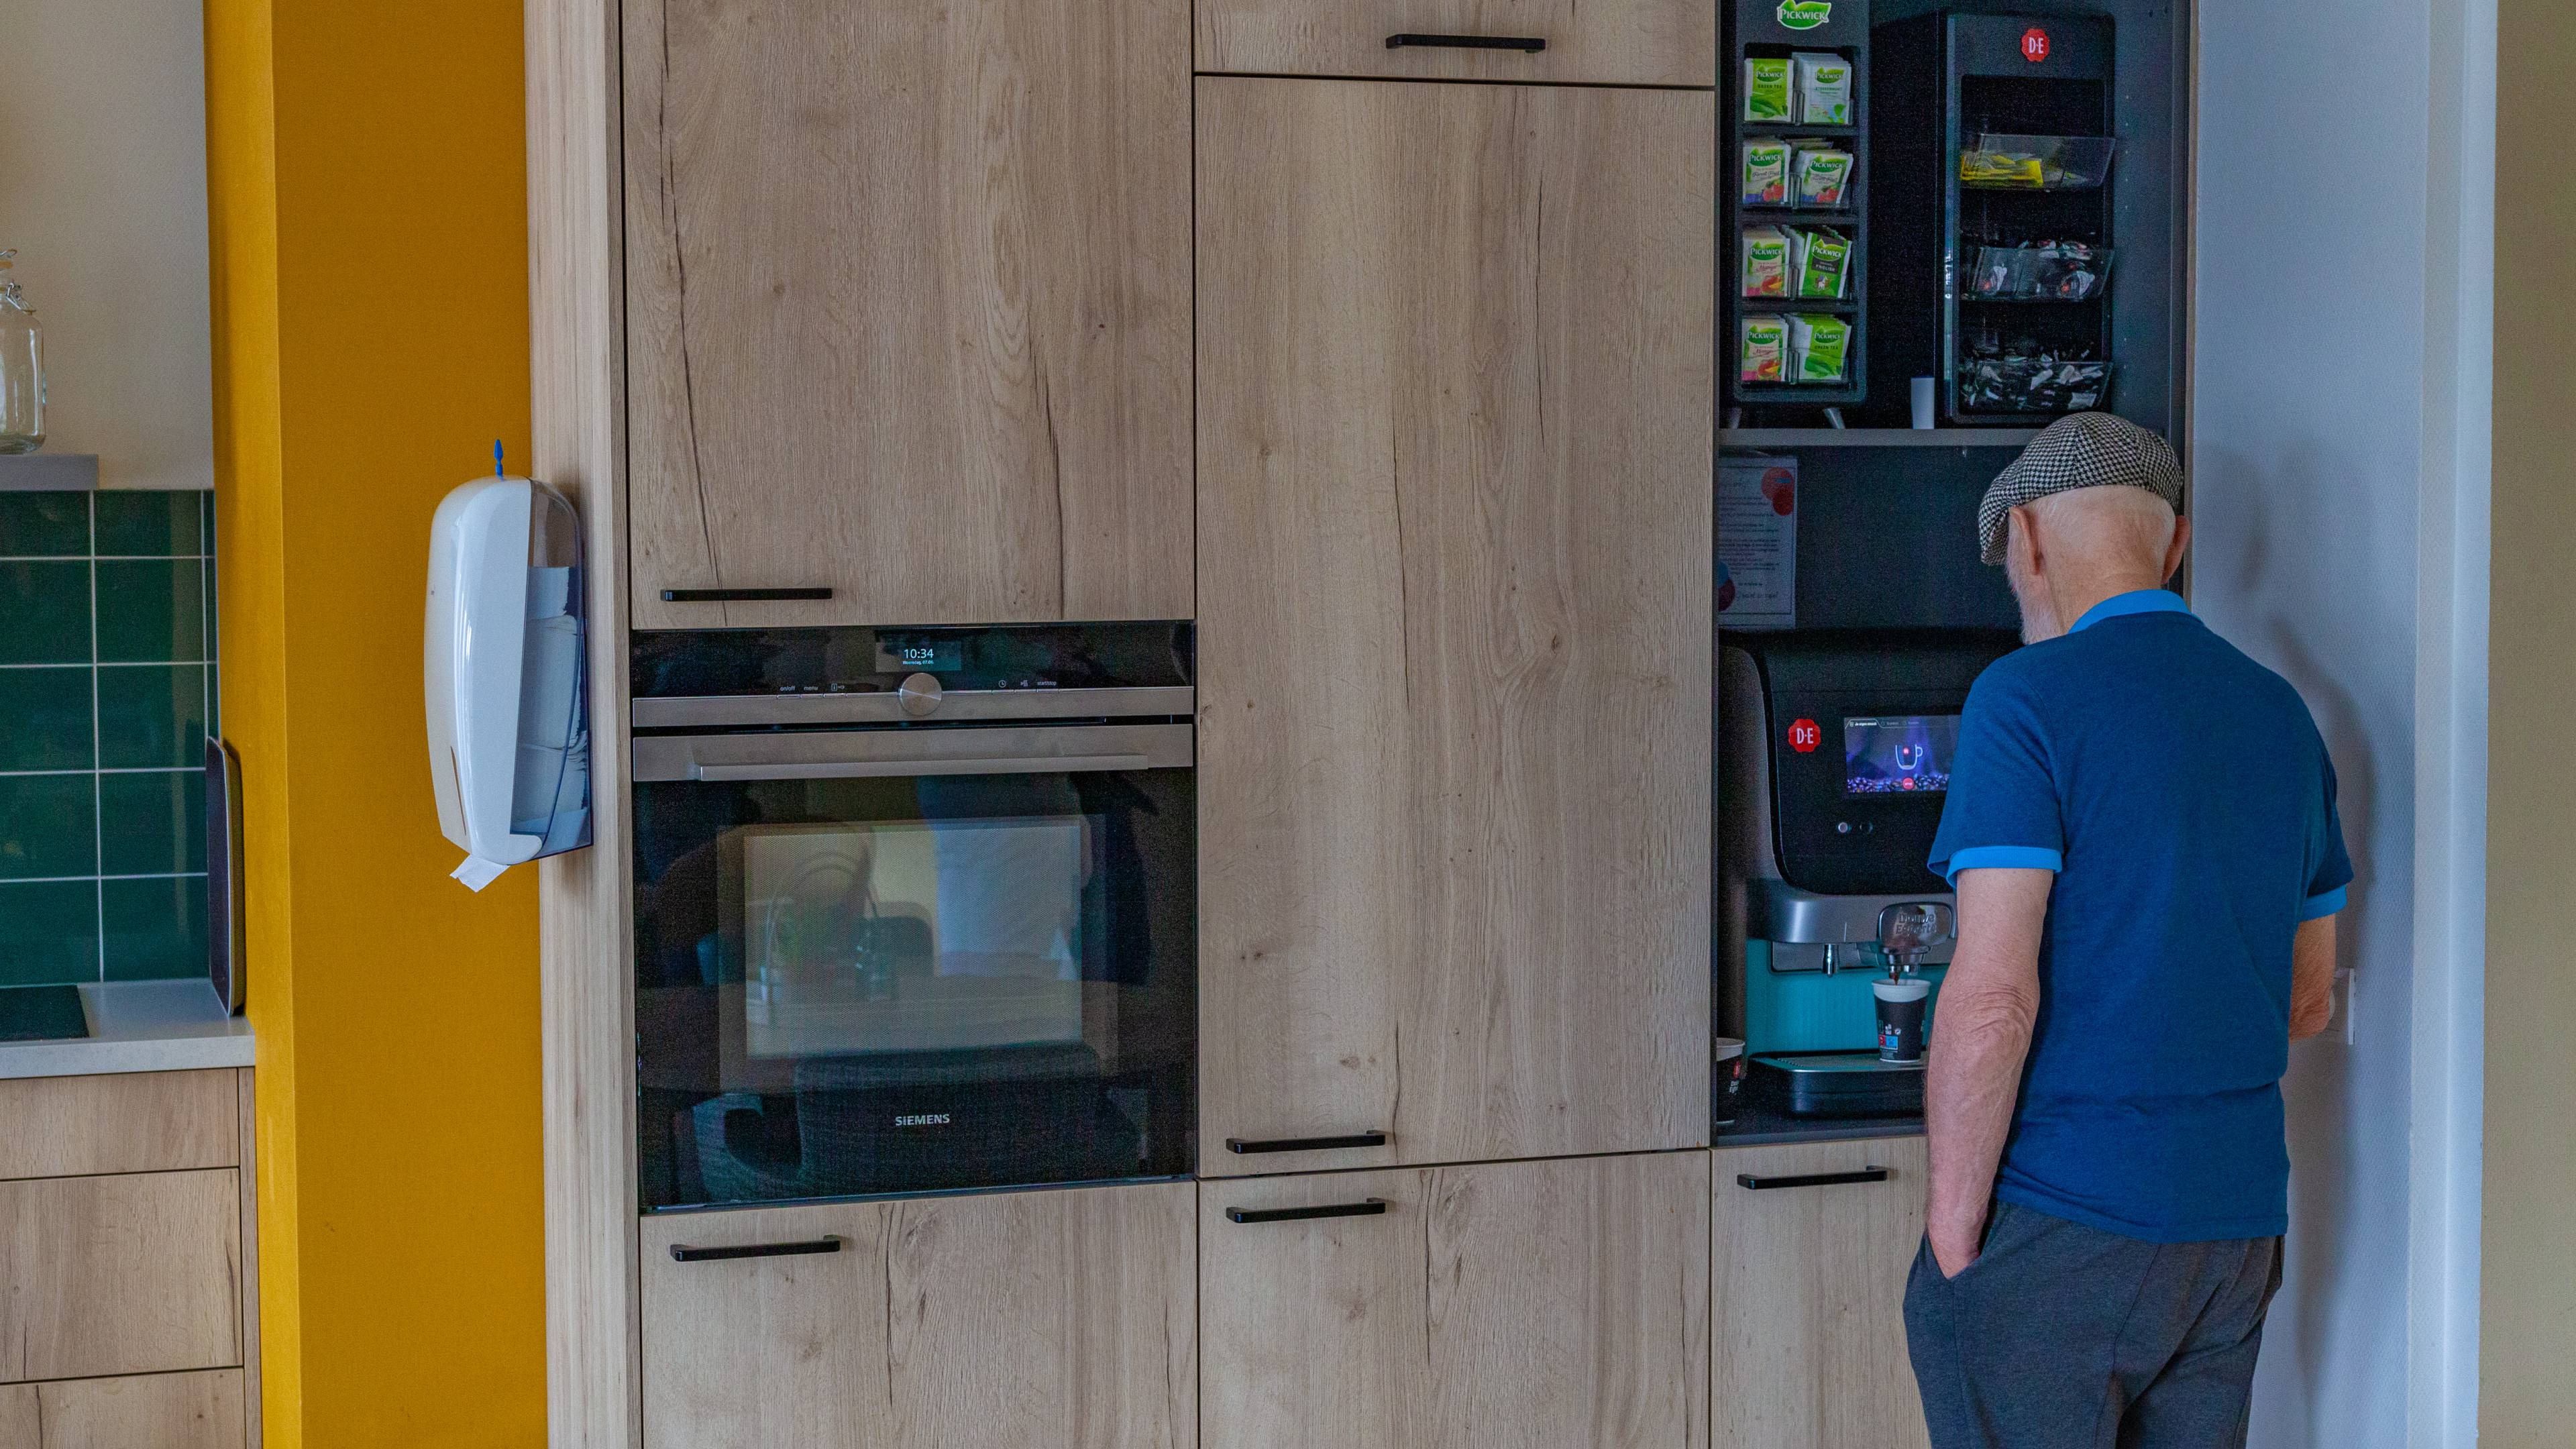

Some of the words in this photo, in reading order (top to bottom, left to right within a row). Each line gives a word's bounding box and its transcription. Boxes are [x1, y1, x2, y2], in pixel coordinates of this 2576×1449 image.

[1779, 9, 1827, 21] PICKWICK
[1749, 154, 1782, 162] PICKWICK
[1810, 160, 1843, 168] PICKWICK
[1750, 248, 1782, 256] PICKWICK
[1812, 246, 1842, 258] PICKWICK
[1747, 331, 1780, 339] PICKWICK
[903, 649, 934, 659] 10:34
[895, 1114, 951, 1126] SIEMENS
